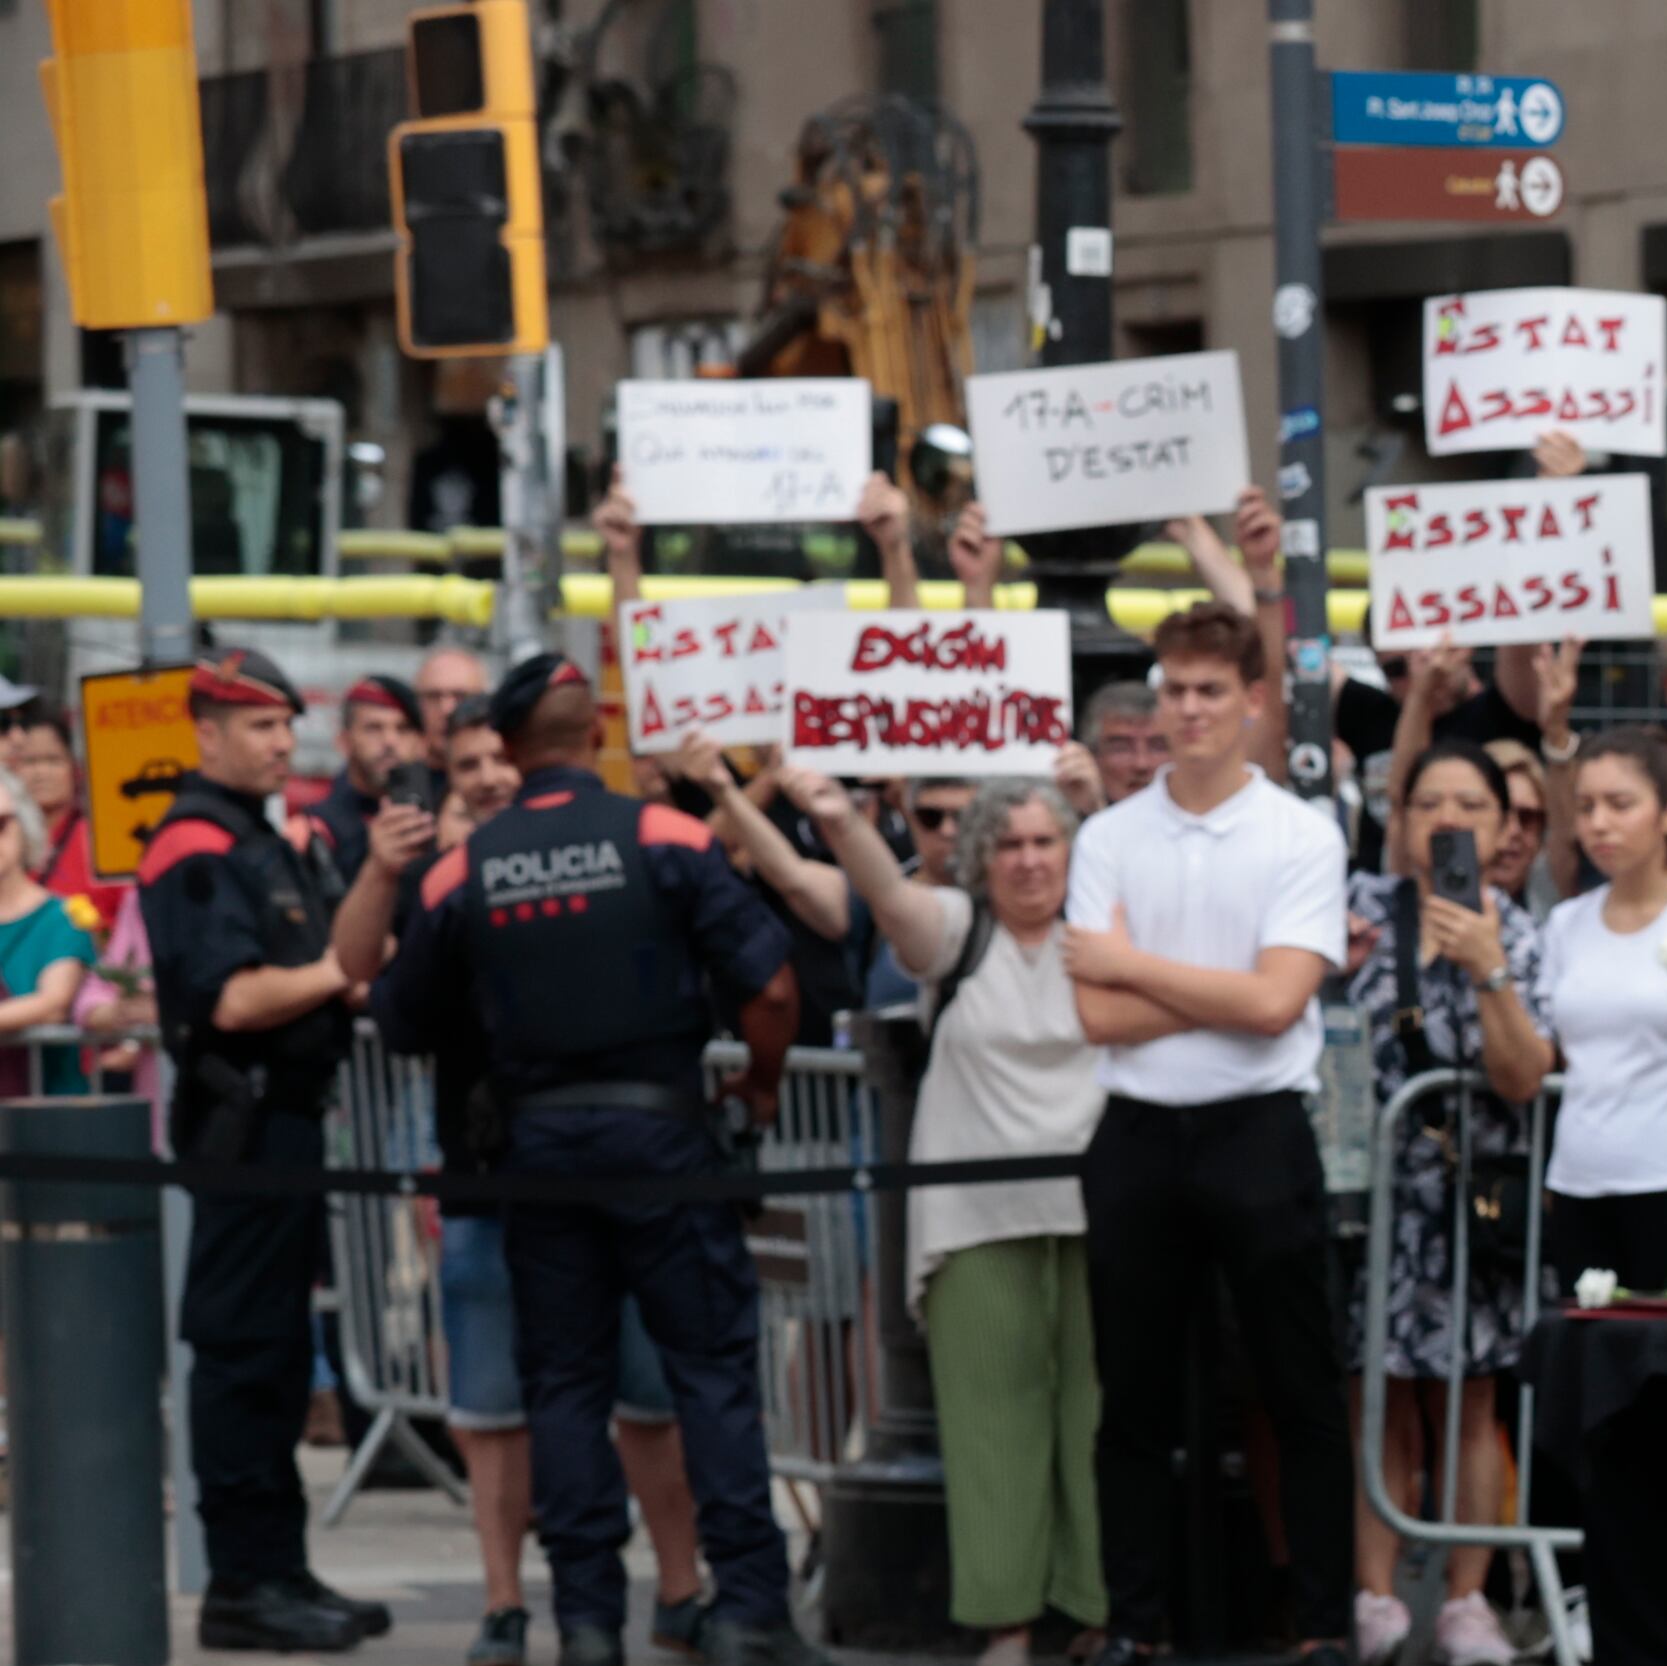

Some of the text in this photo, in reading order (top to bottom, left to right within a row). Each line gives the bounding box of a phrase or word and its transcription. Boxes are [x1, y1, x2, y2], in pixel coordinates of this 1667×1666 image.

[1435, 295, 1625, 356] ESTAT
[1044, 435, 1190, 483] D'ESTAT
[632, 604, 787, 664] ESTA
[640, 681, 785, 738] ASSA
[482, 841, 623, 891] POLICIA
